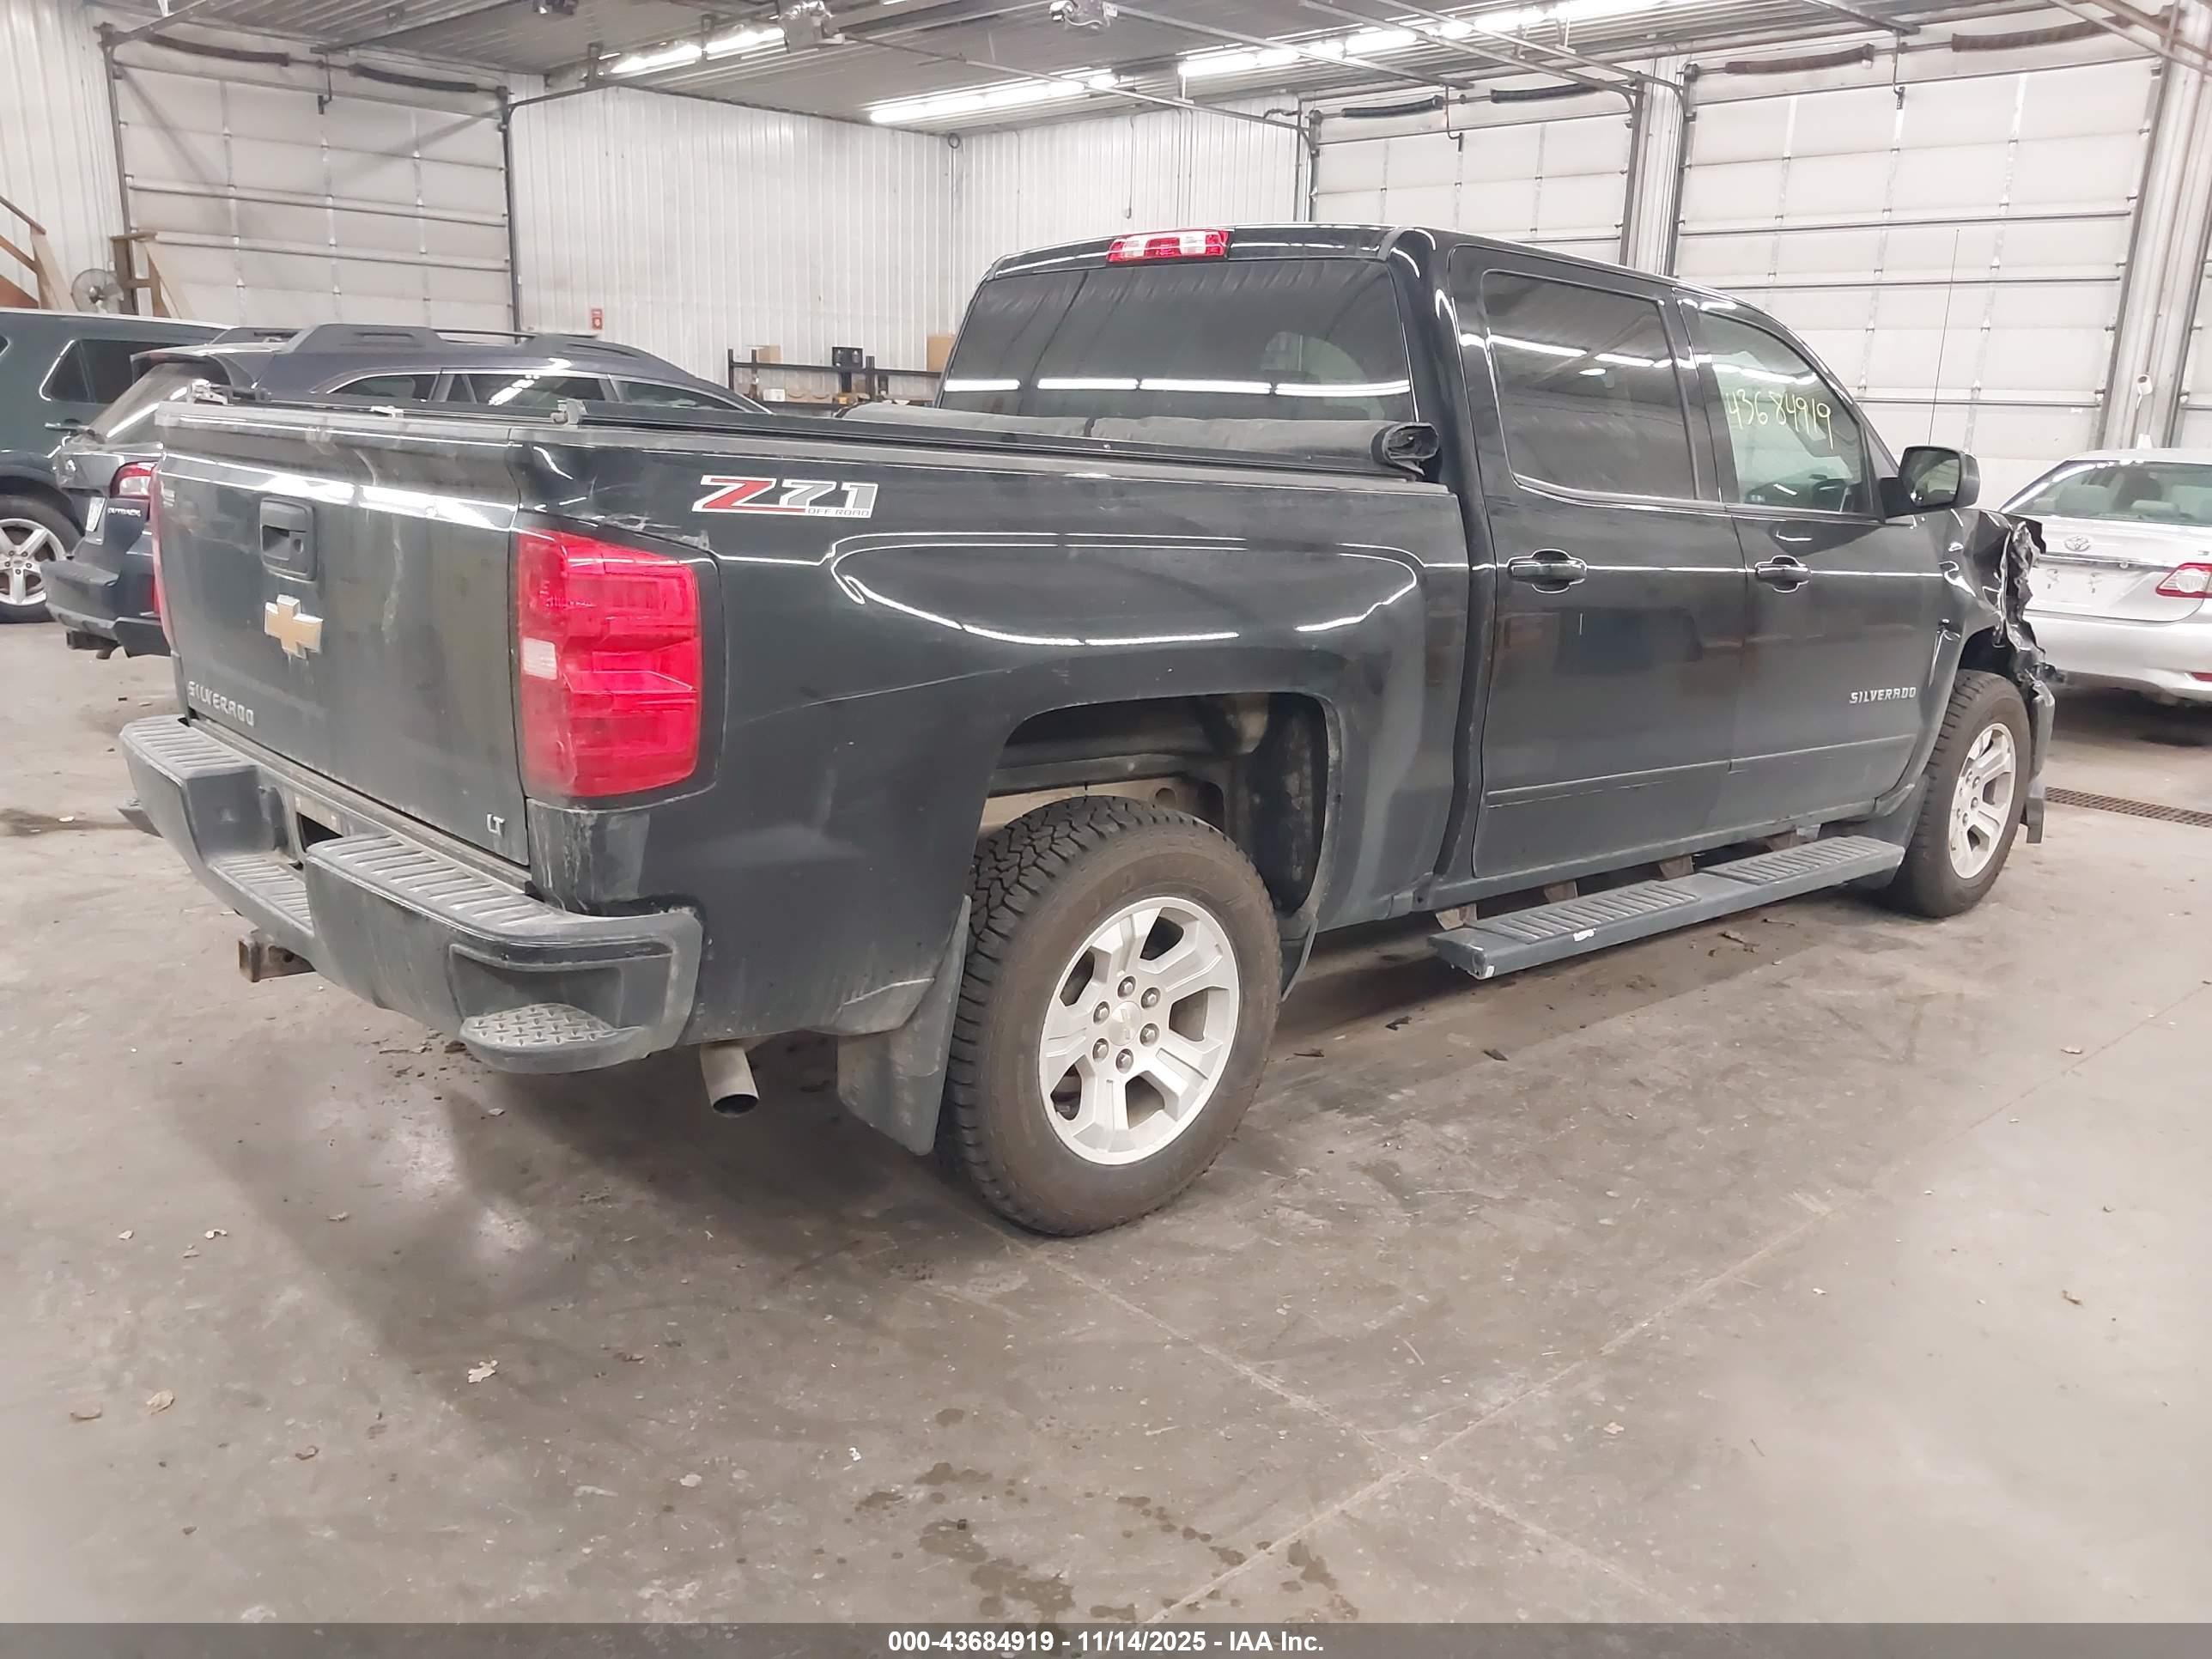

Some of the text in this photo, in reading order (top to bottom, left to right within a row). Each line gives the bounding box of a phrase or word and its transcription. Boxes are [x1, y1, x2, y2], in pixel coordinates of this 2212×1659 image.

[692, 475, 878, 514] Z71
[188, 681, 255, 727] SILVERADO
[1849, 687, 1917, 703] SILVERADO
[487, 813, 505, 836] LT
